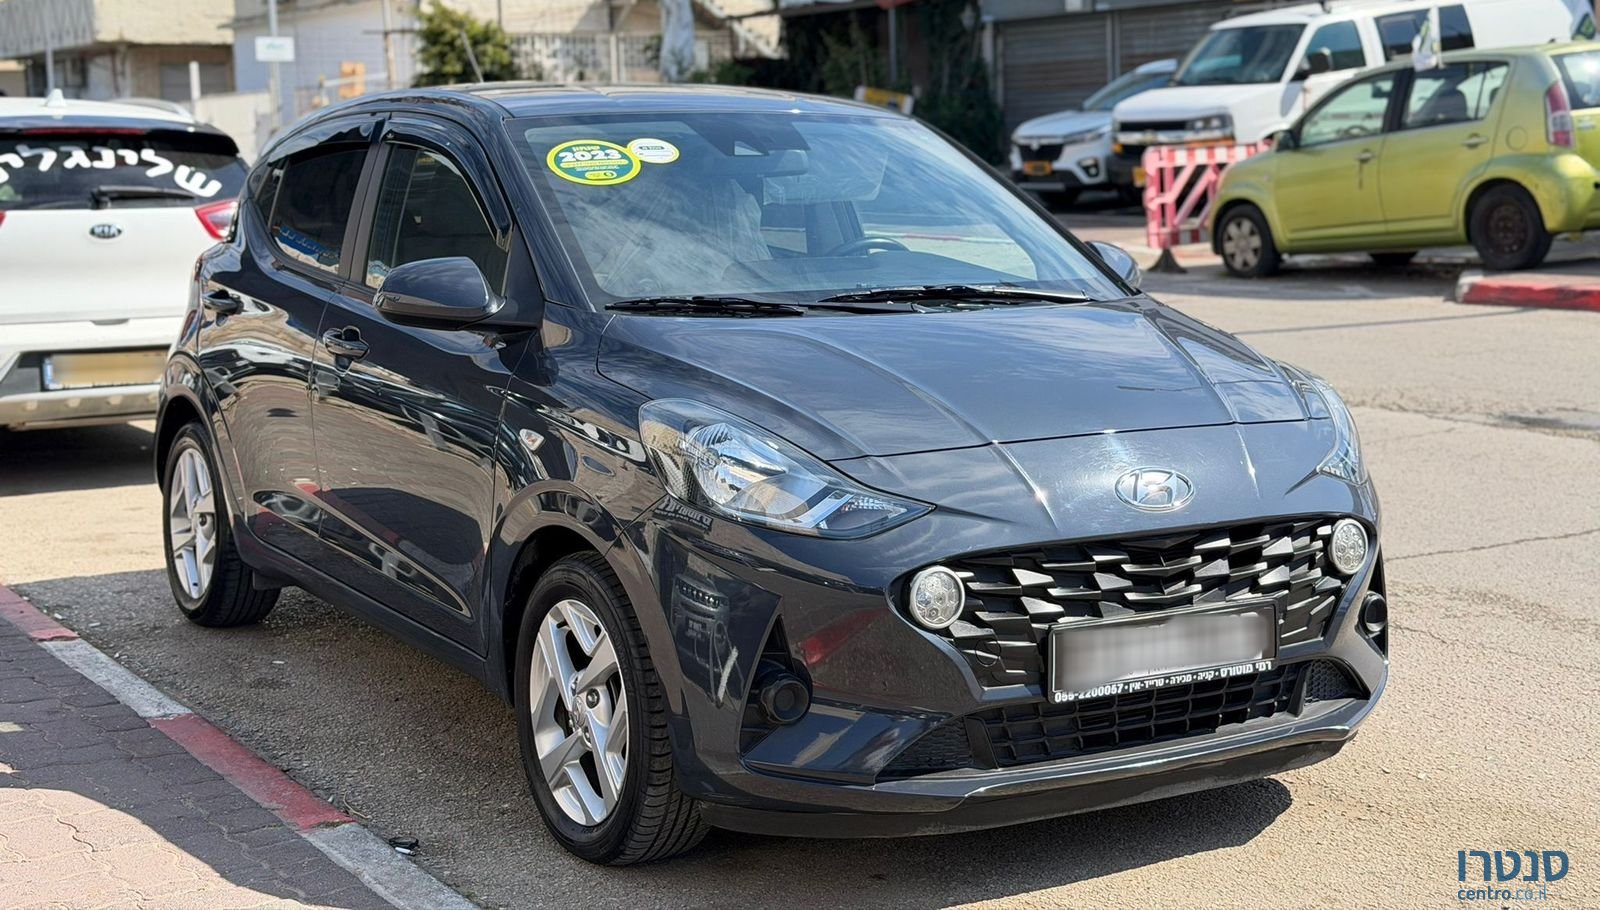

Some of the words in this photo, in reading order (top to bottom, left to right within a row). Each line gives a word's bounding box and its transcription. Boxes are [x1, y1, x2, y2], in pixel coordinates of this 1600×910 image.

[558, 149, 622, 163] 2023
[1220, 663, 1254, 678] מוטורס
[1255, 660, 1272, 671] רמי
[1169, 674, 1192, 685] מכירה
[1197, 670, 1215, 681] קניה
[1129, 678, 1164, 693] טרייד-אין
